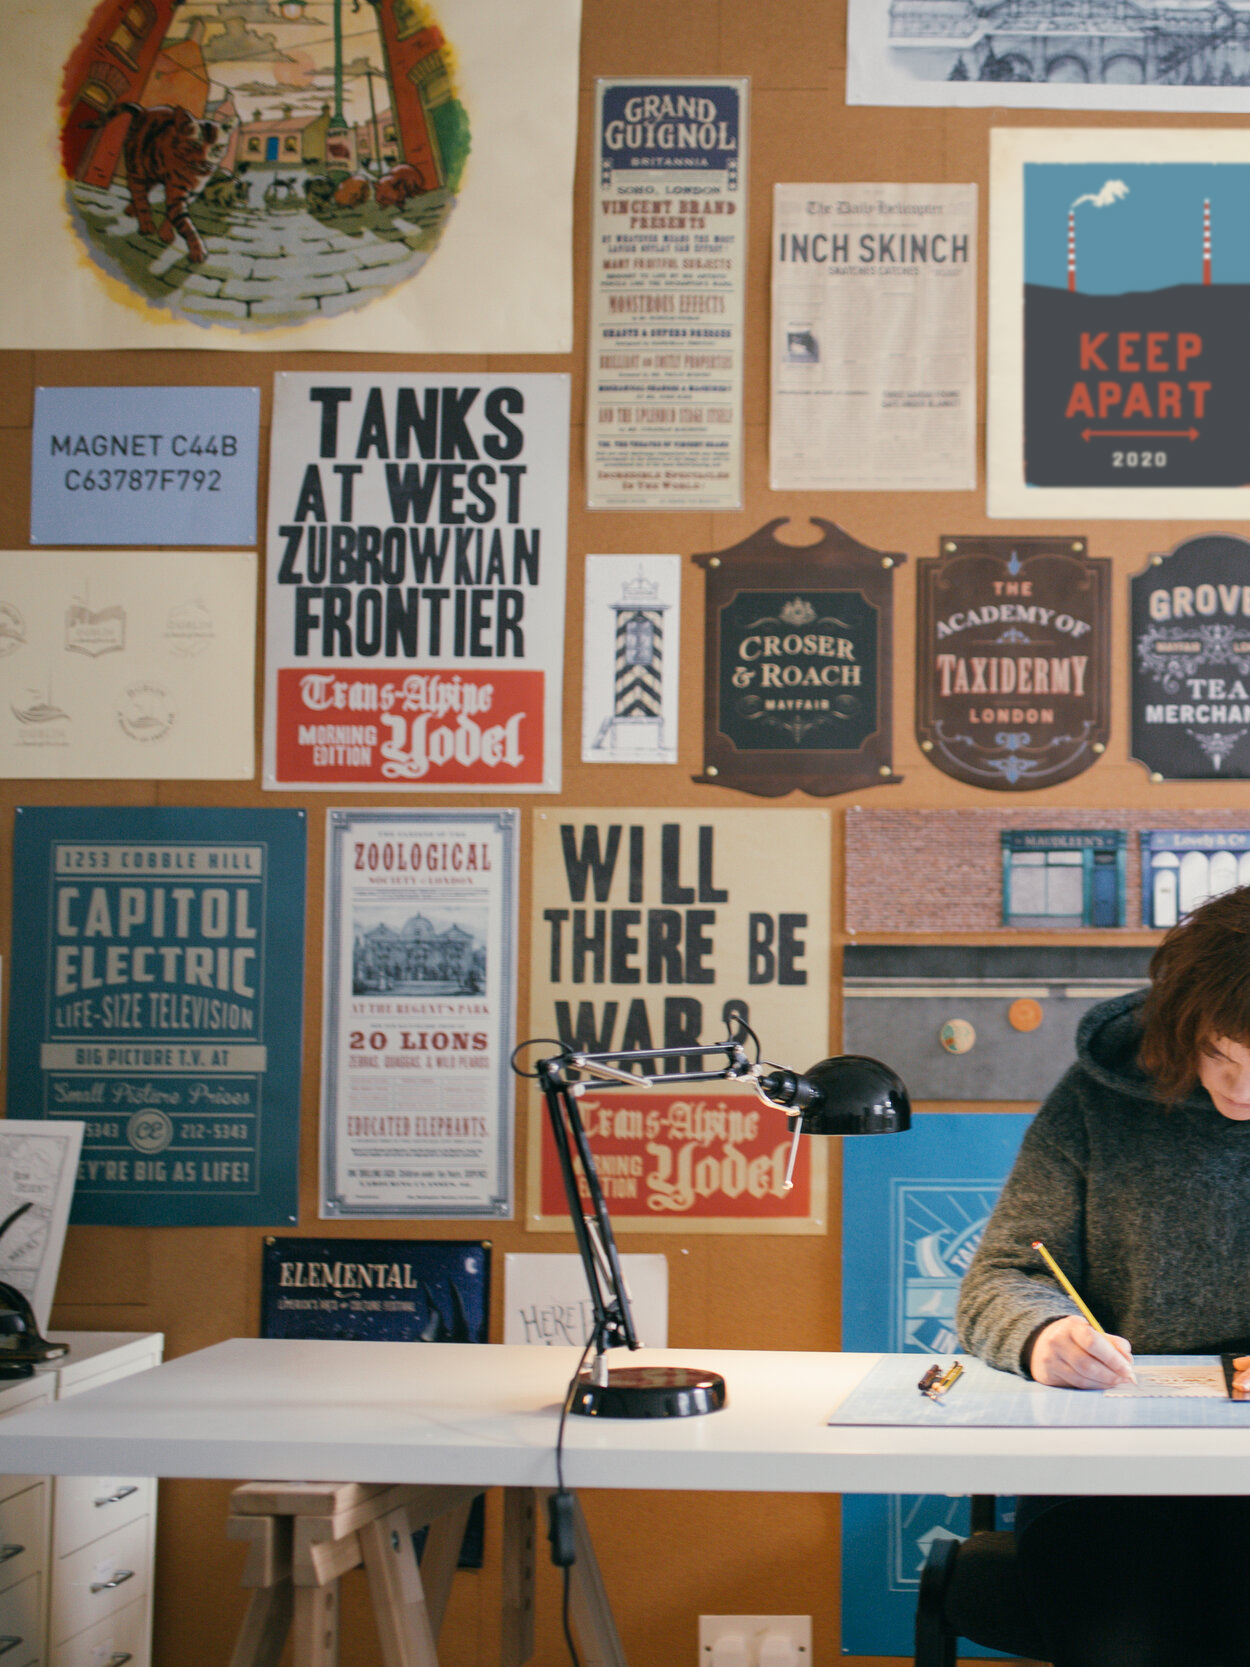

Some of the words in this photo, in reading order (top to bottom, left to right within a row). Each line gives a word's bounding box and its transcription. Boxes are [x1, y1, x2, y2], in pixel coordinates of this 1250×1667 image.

[624, 94, 717, 123] GRAND
[605, 121, 736, 150] GUIGNOL
[631, 157, 709, 167] BRITANNIA
[666, 186, 720, 194] LONDON
[601, 200, 673, 215] VINCENT
[679, 201, 736, 215] BRAND
[630, 217, 705, 229] PRESENTS
[779, 233, 848, 263] INCH
[858, 233, 969, 263] SKINCH
[1080, 332, 1202, 372] KEEP
[1065, 381, 1212, 418] APART
[310, 386, 524, 460] TANKS
[50, 435, 163, 456] MAGNET
[171, 435, 238, 456] C44B
[1112, 451, 1167, 467] 2020
[64, 469, 222, 491] C63787F792
[294, 464, 363, 523] AT
[385, 463, 527, 524] WEST
[277, 525, 540, 586] ZUBROWKIAN
[993, 581, 1033, 597] THE
[294, 586, 525, 658] FRONTIER
[936, 604, 1056, 639] ACADEMY
[1054, 614, 1092, 638] OF
[739, 634, 856, 662] CROSER
[731, 666, 756, 688] &
[760, 663, 862, 688] ROACH
[936, 654, 1088, 697] TAXIDERMY
[299, 674, 494, 718] Trans-Alpine
[1187, 679, 1249, 700] TEA
[764, 699, 830, 711] MAYFAIR
[969, 708, 1054, 724] LONDON
[298, 725, 377, 745] MORNING
[380, 712, 526, 779] Yodel
[313, 746, 372, 766] EDITION
[65, 852, 110, 868] 1253
[121, 852, 196, 869] COBBLE
[208, 853, 252, 869] HILL
[354, 842, 491, 871] ZOOLOGICAL
[560, 824, 728, 904] WILL
[57, 887, 257, 939] CAPITOL
[544, 909, 716, 985] THERE
[749, 913, 807, 985] BE
[55, 945, 256, 999] ELECTRIC
[55, 993, 142, 1029] LIFE-SIZE
[149, 993, 253, 1030] TELEVISION
[349, 1031, 388, 1051] 20
[400, 1031, 488, 1051] LIONS
[75, 1048, 103, 1065] BIG
[107, 1048, 172, 1066] PICTURE
[211, 1050, 230, 1067] AT
[54, 1083, 106, 1103] Small
[188, 1083, 250, 1106] Prices
[181, 1123, 248, 1139] 212-5343
[347, 1116, 410, 1136] EDUCATED
[79, 1161, 129, 1181] EY'RE
[135, 1162, 166, 1181] BIG
[172, 1162, 196, 1182] AS
[202, 1162, 249, 1183] LIFE!
[279, 1262, 418, 1289] ELEMENTAL
